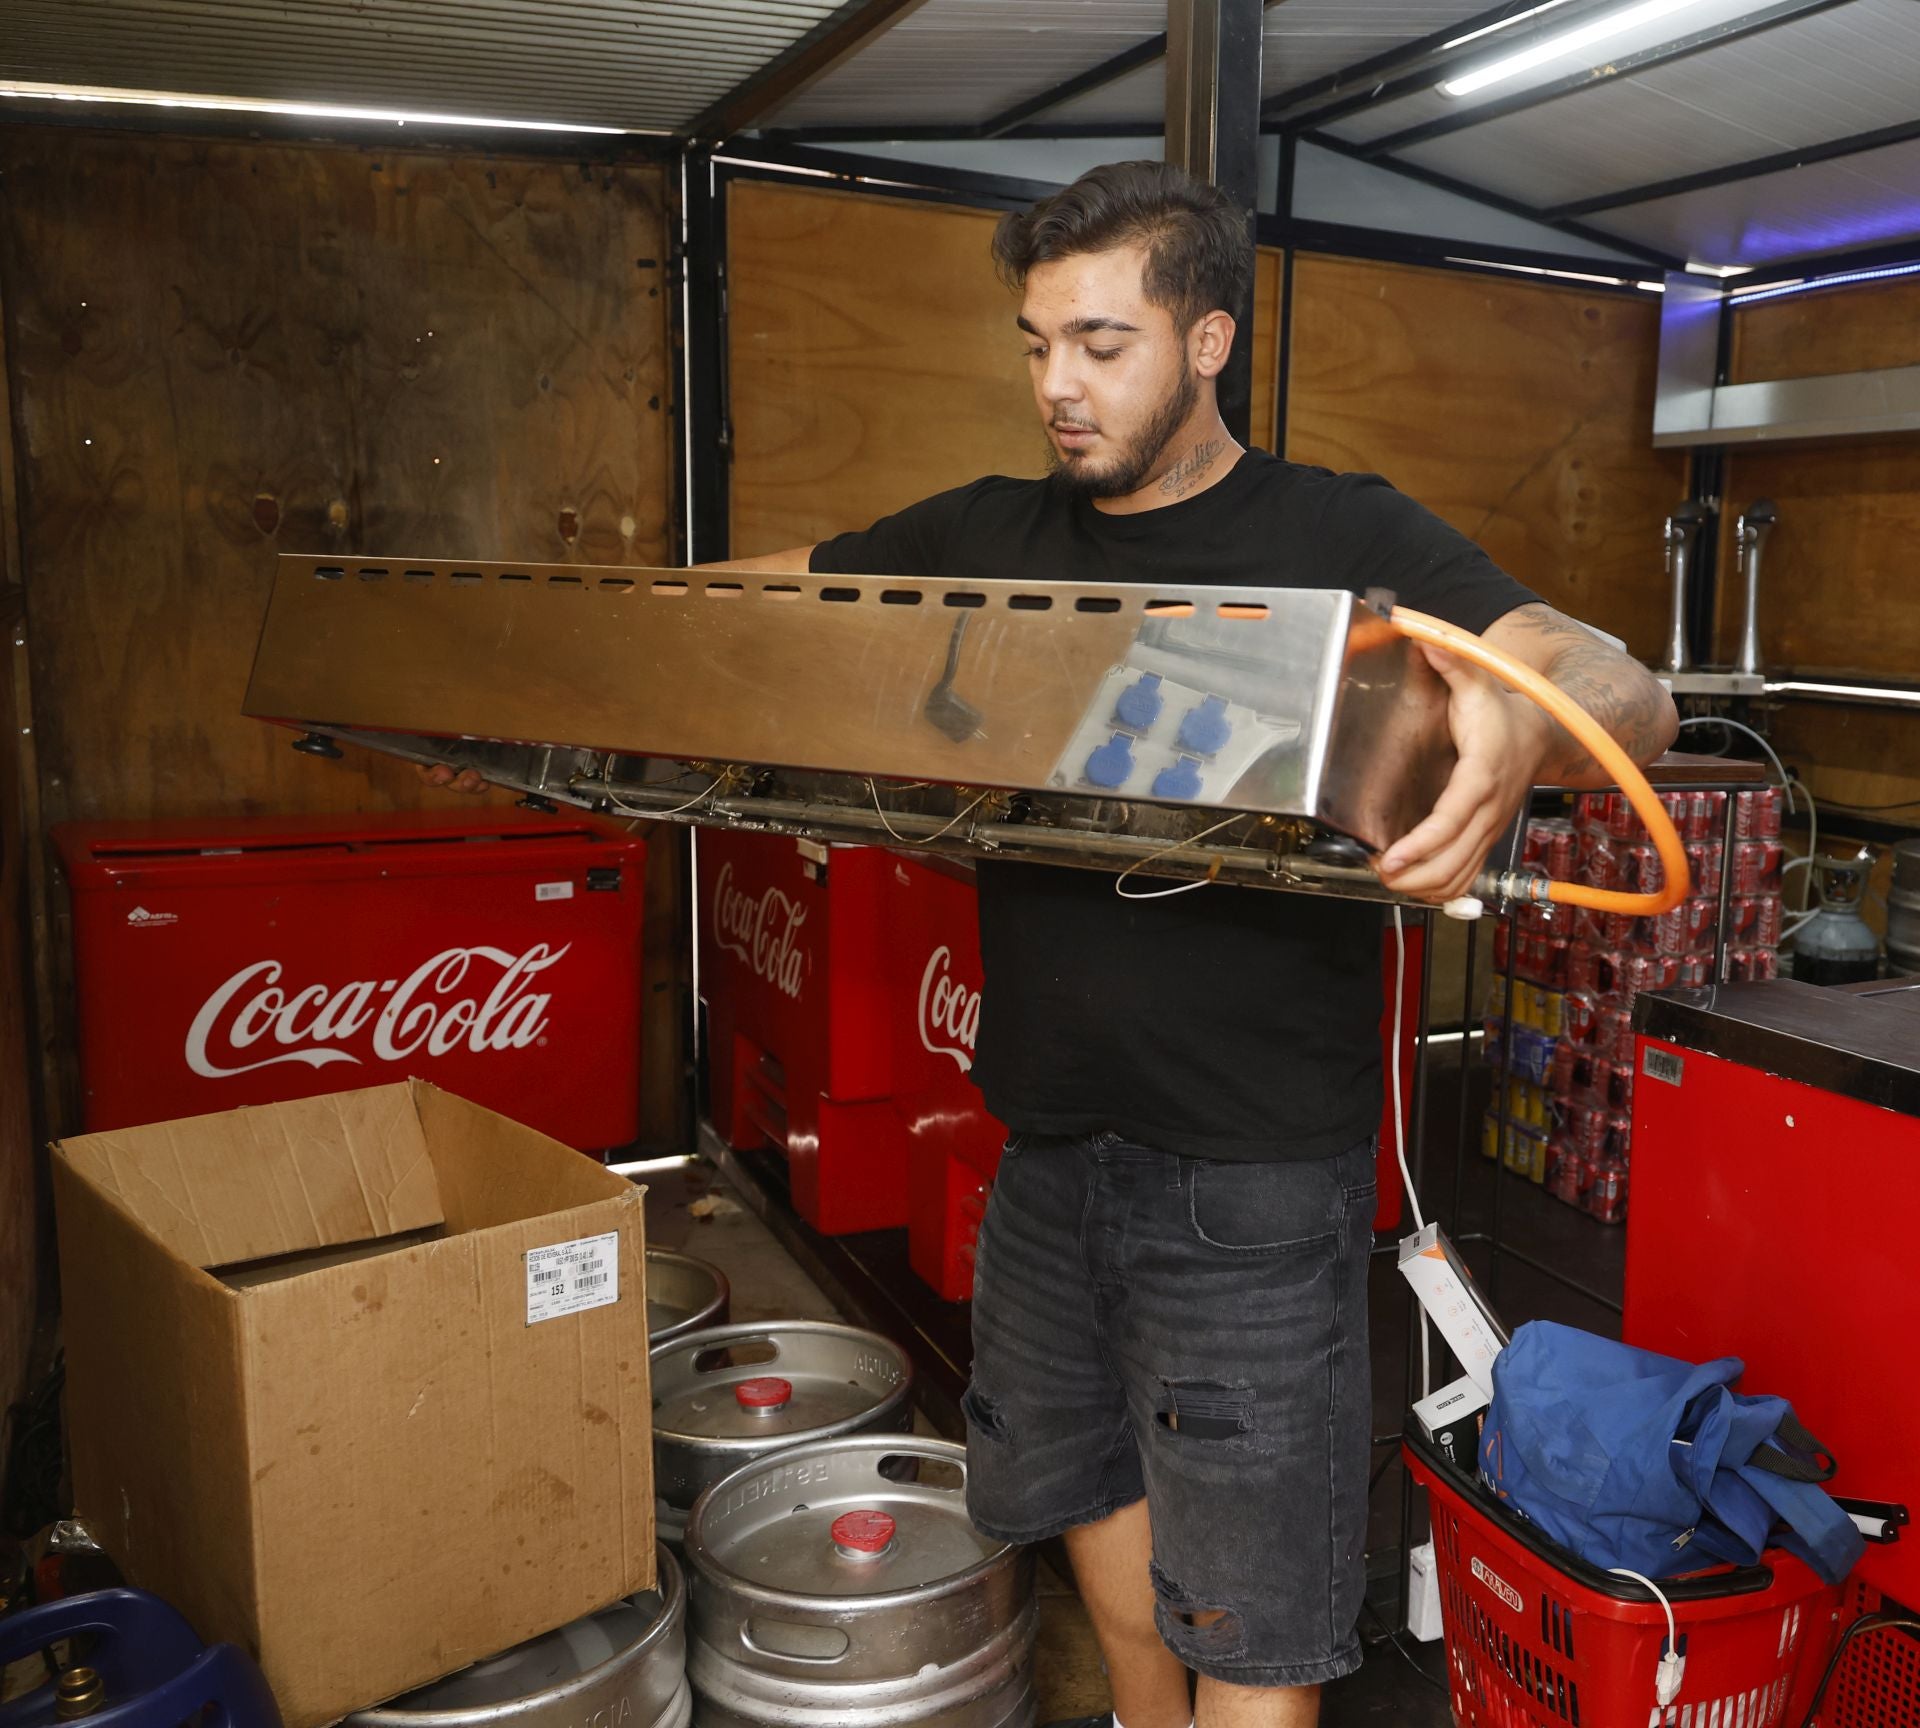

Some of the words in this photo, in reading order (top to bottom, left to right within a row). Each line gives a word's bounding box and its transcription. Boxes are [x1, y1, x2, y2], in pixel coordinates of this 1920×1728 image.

[713, 861, 807, 998] Coca-Cola
[185, 942, 572, 1078] Coca-Cola
[551, 1283, 564, 1296] 152
